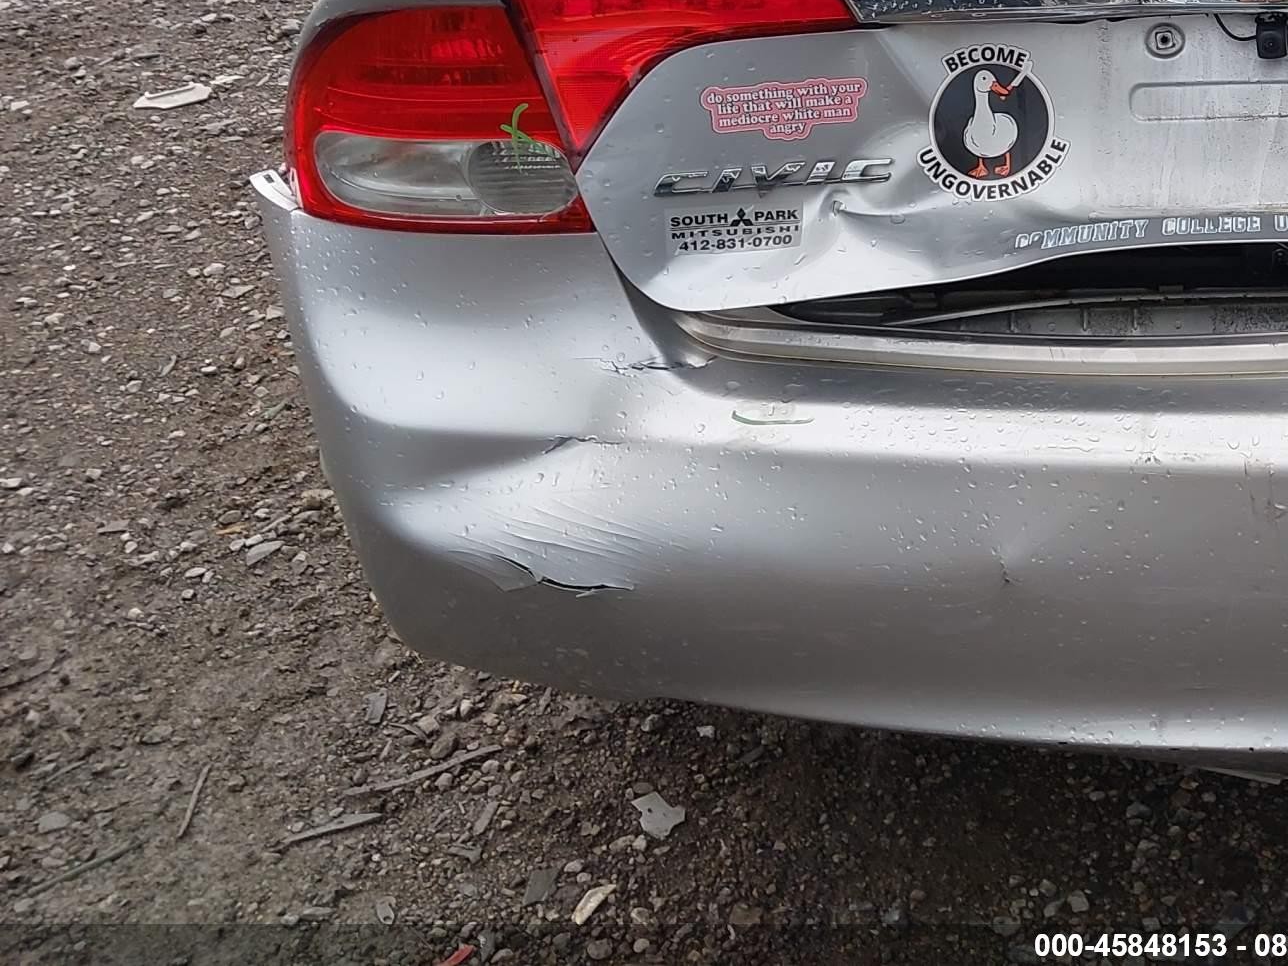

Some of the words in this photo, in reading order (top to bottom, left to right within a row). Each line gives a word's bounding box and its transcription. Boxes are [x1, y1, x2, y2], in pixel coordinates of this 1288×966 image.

[944, 46, 1027, 73] BECOME
[707, 92, 723, 104] do
[726, 87, 794, 103] something
[799, 84, 828, 96] with
[831, 84, 861, 96] your
[717, 102, 739, 115] life
[743, 100, 773, 112] that
[776, 97, 803, 110] will
[805, 95, 841, 107] make
[844, 96, 852, 104] a
[719, 113, 779, 127] mediocre
[783, 109, 821, 122] white
[824, 108, 851, 118] man
[769, 121, 806, 134] angry
[653, 158, 893, 197] CIVIC
[919, 138, 1067, 200] UNGOVERNABLE
[670, 213, 729, 227] SOUTH
[754, 209, 798, 221] PARK
[1162, 216, 1261, 235] COLLEGE
[671, 225, 799, 240] MITSUBISHI
[679, 234, 793, 251] 412-831-0700
